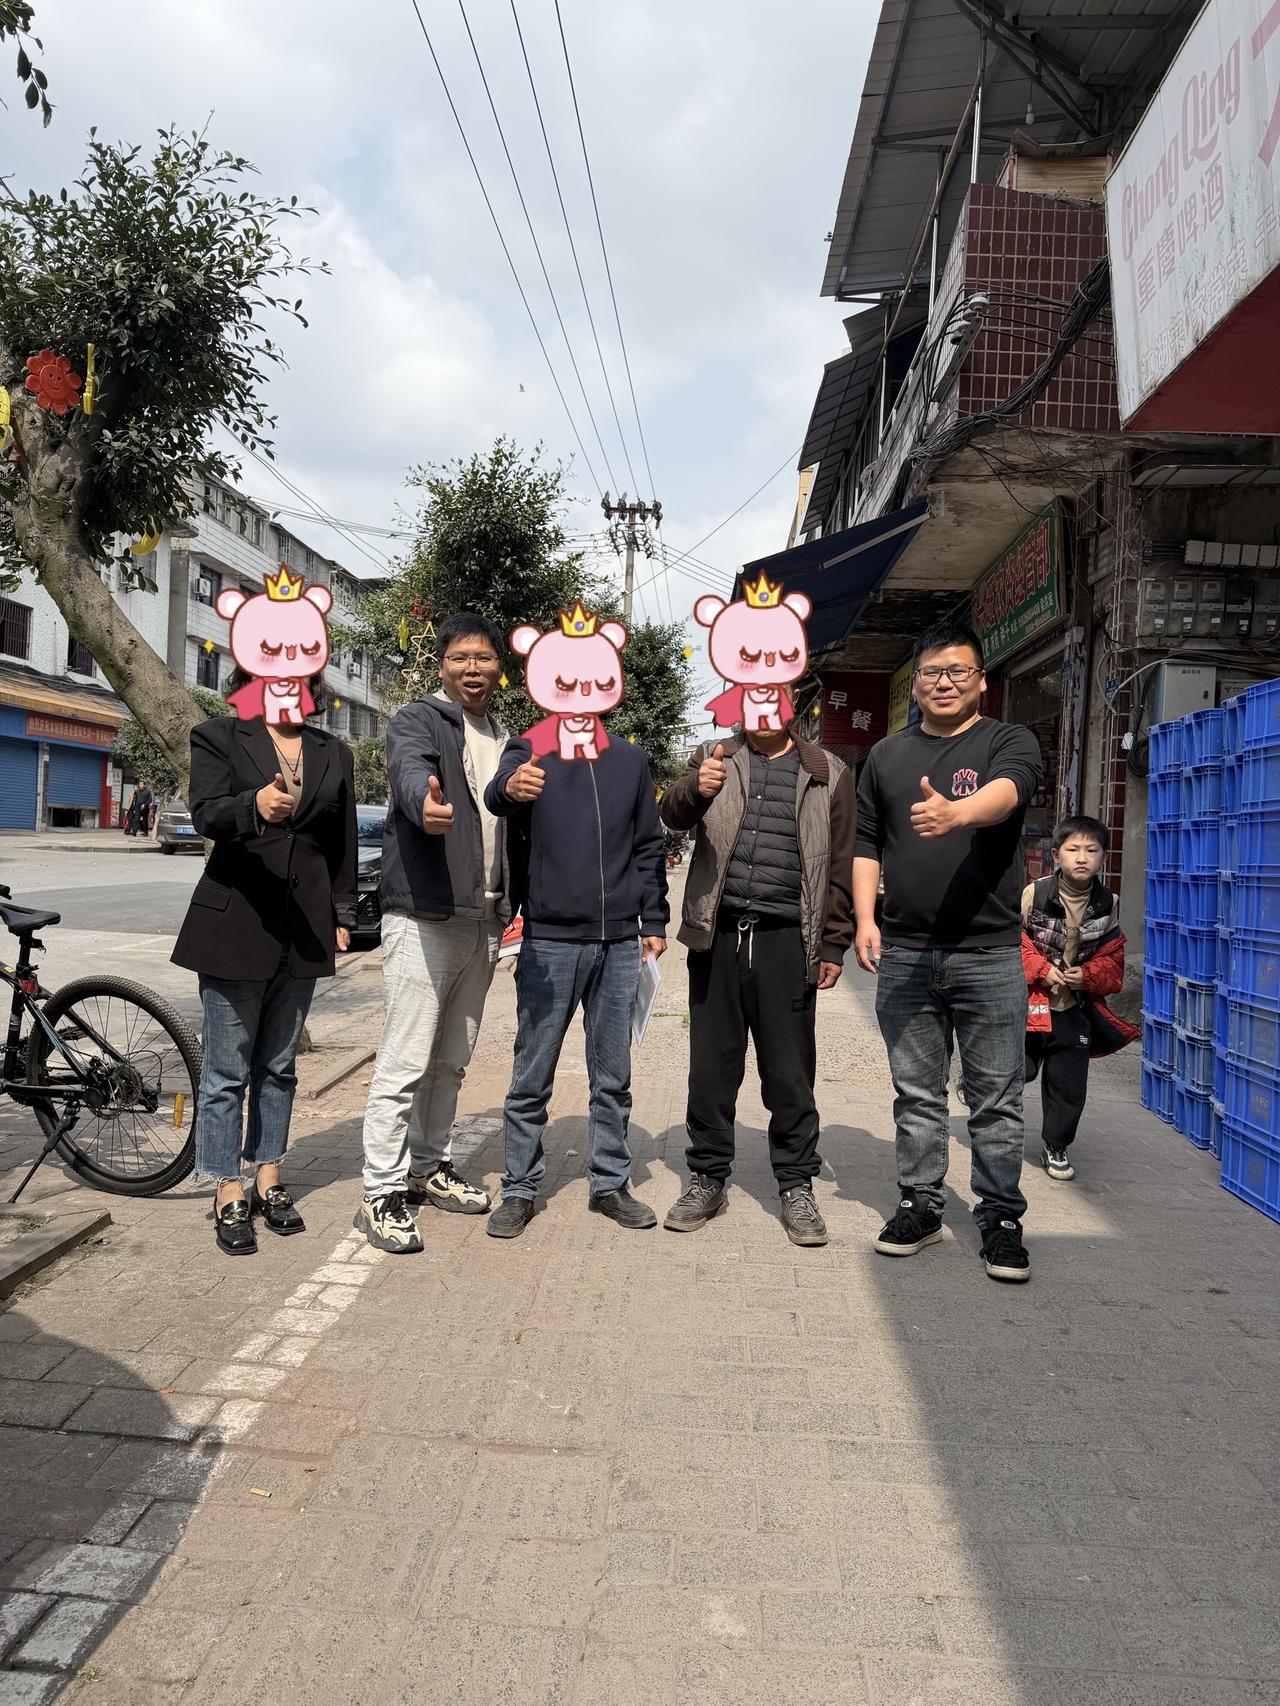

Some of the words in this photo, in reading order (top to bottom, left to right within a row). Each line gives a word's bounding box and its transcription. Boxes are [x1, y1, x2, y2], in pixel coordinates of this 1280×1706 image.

[1136, 151, 1226, 315] 重慶啤酒
[828, 690, 872, 732] 早餐
